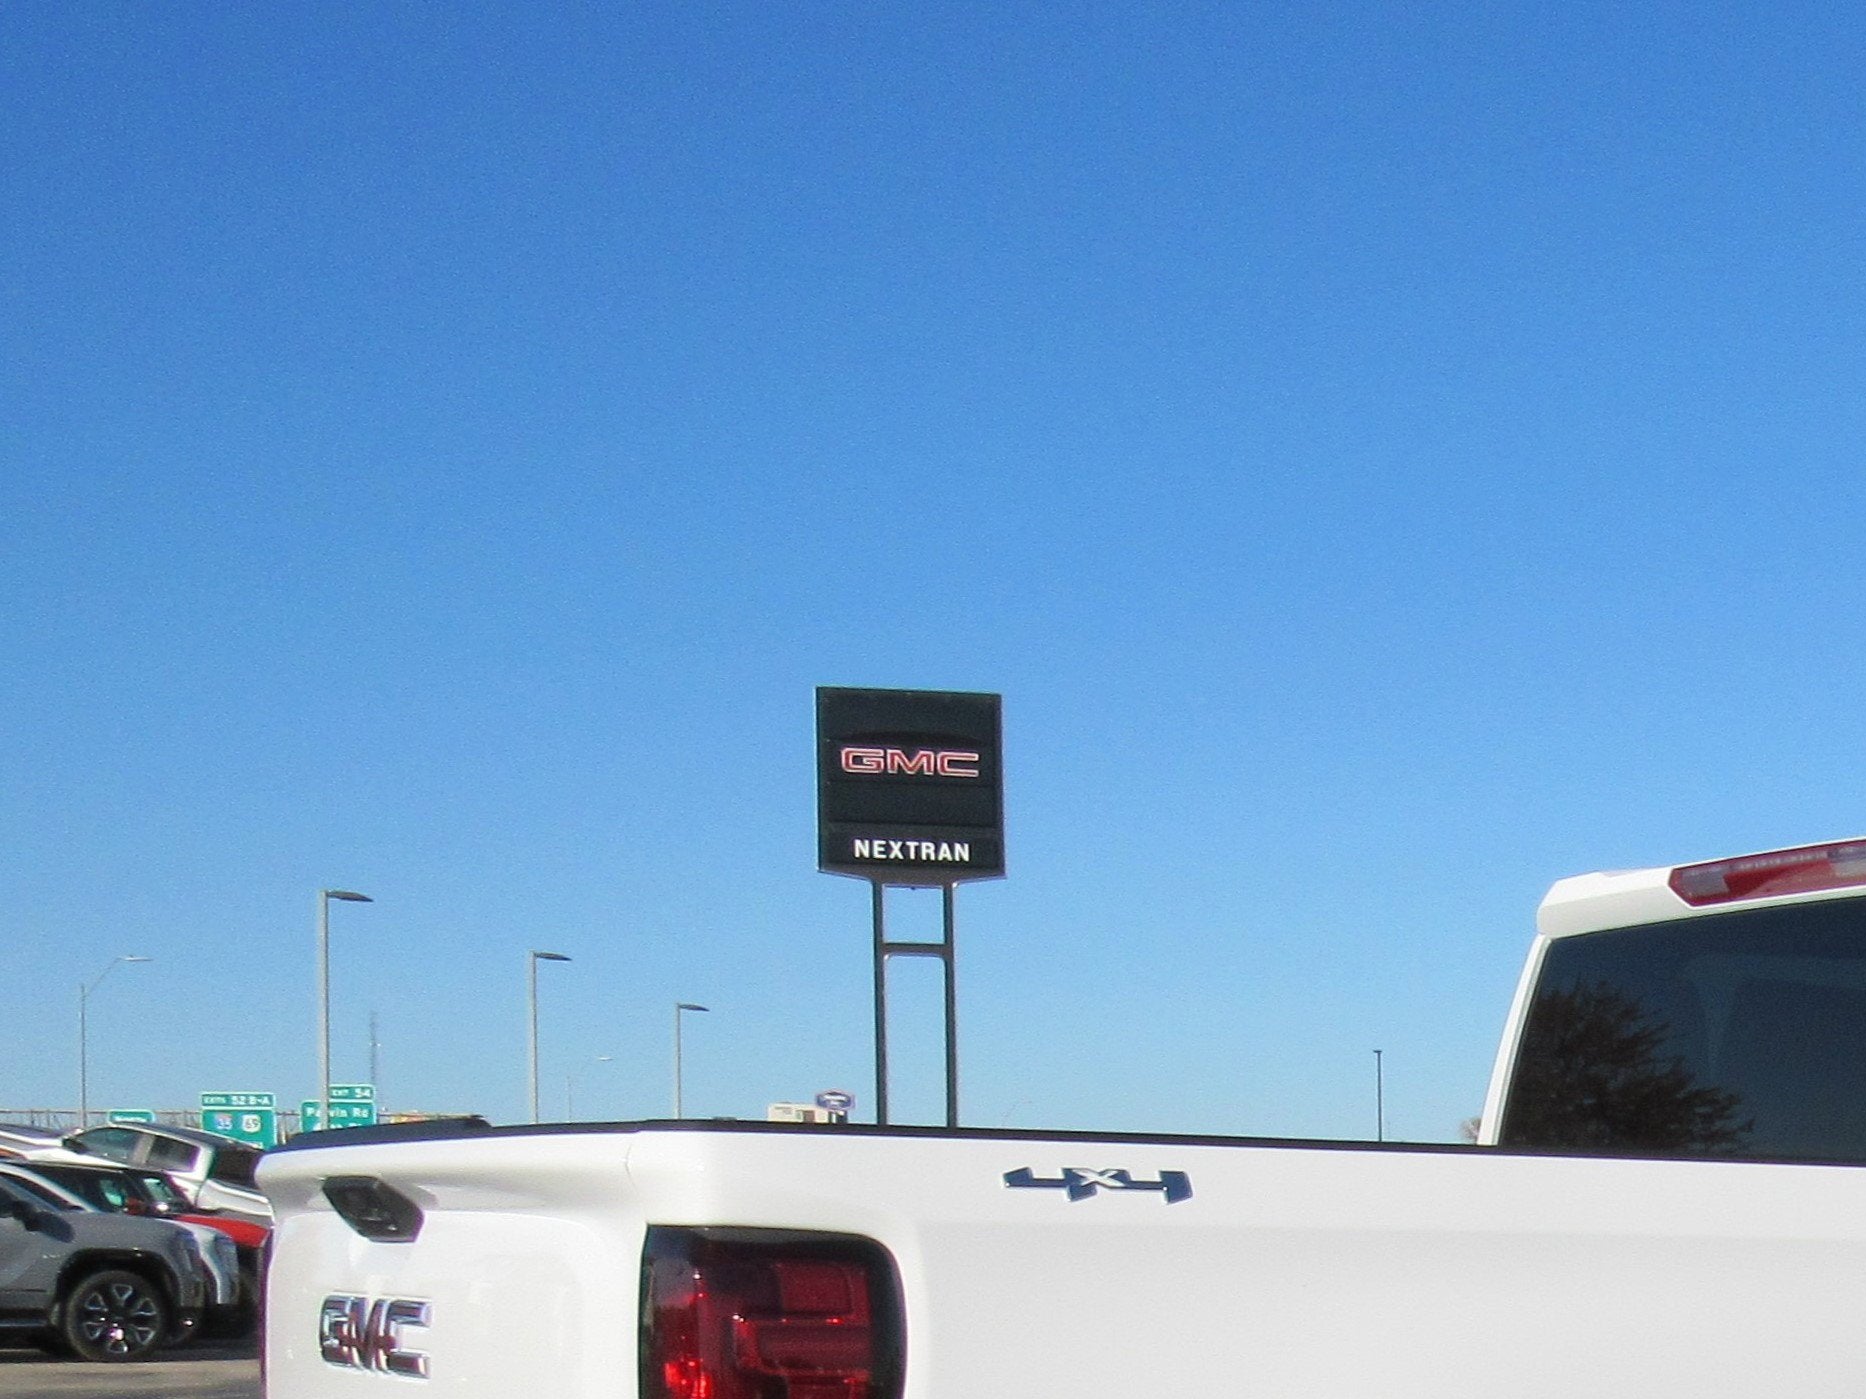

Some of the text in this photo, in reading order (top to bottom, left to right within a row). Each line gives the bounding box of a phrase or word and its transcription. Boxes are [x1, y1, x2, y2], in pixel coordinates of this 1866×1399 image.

[841, 747, 979, 777] GMC
[854, 839, 970, 862] NEXTRAN
[355, 1088, 371, 1098] 54
[306, 1107, 347, 1117] Pavin
[320, 1294, 433, 1380] GMC
